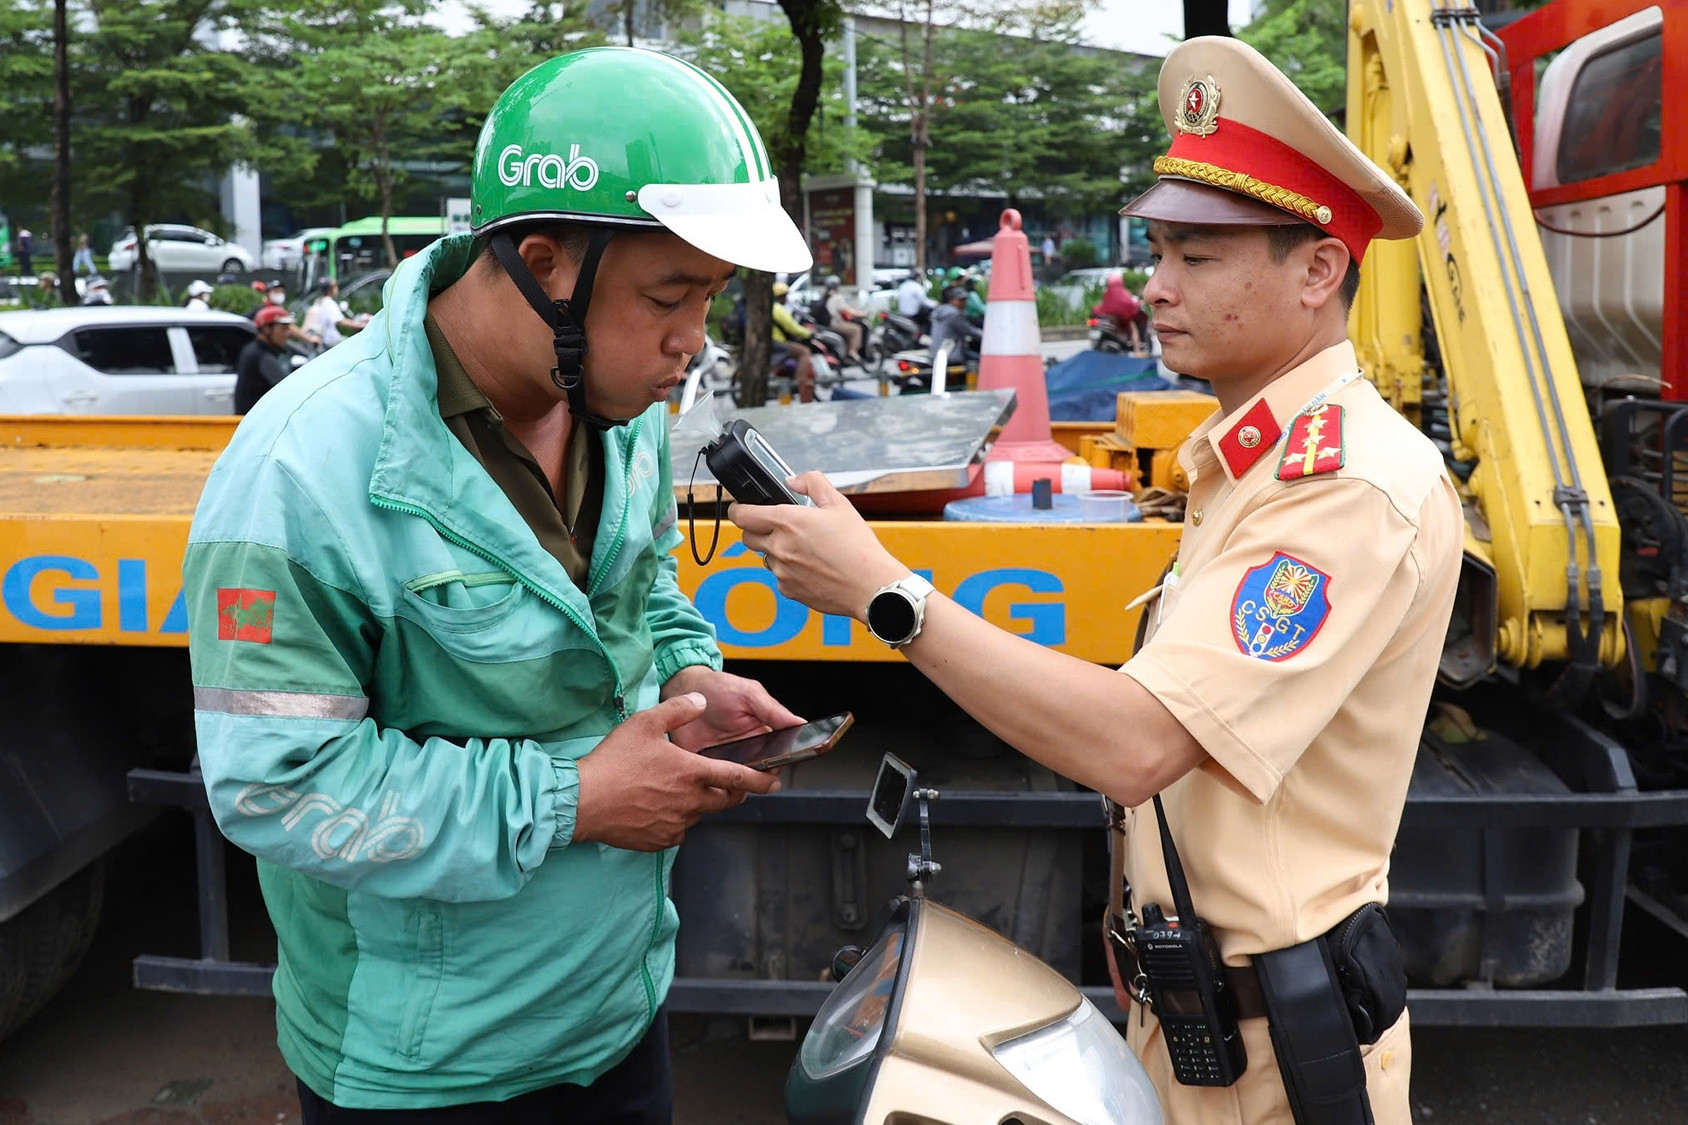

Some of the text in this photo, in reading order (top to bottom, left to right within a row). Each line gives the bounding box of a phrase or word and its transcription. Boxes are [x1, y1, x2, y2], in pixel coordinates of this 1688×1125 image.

[498, 143, 600, 192] Grab
[693, 541, 1066, 648] ÔG
[1241, 600, 1306, 641] CSGT
[235, 783, 425, 863] Grab
